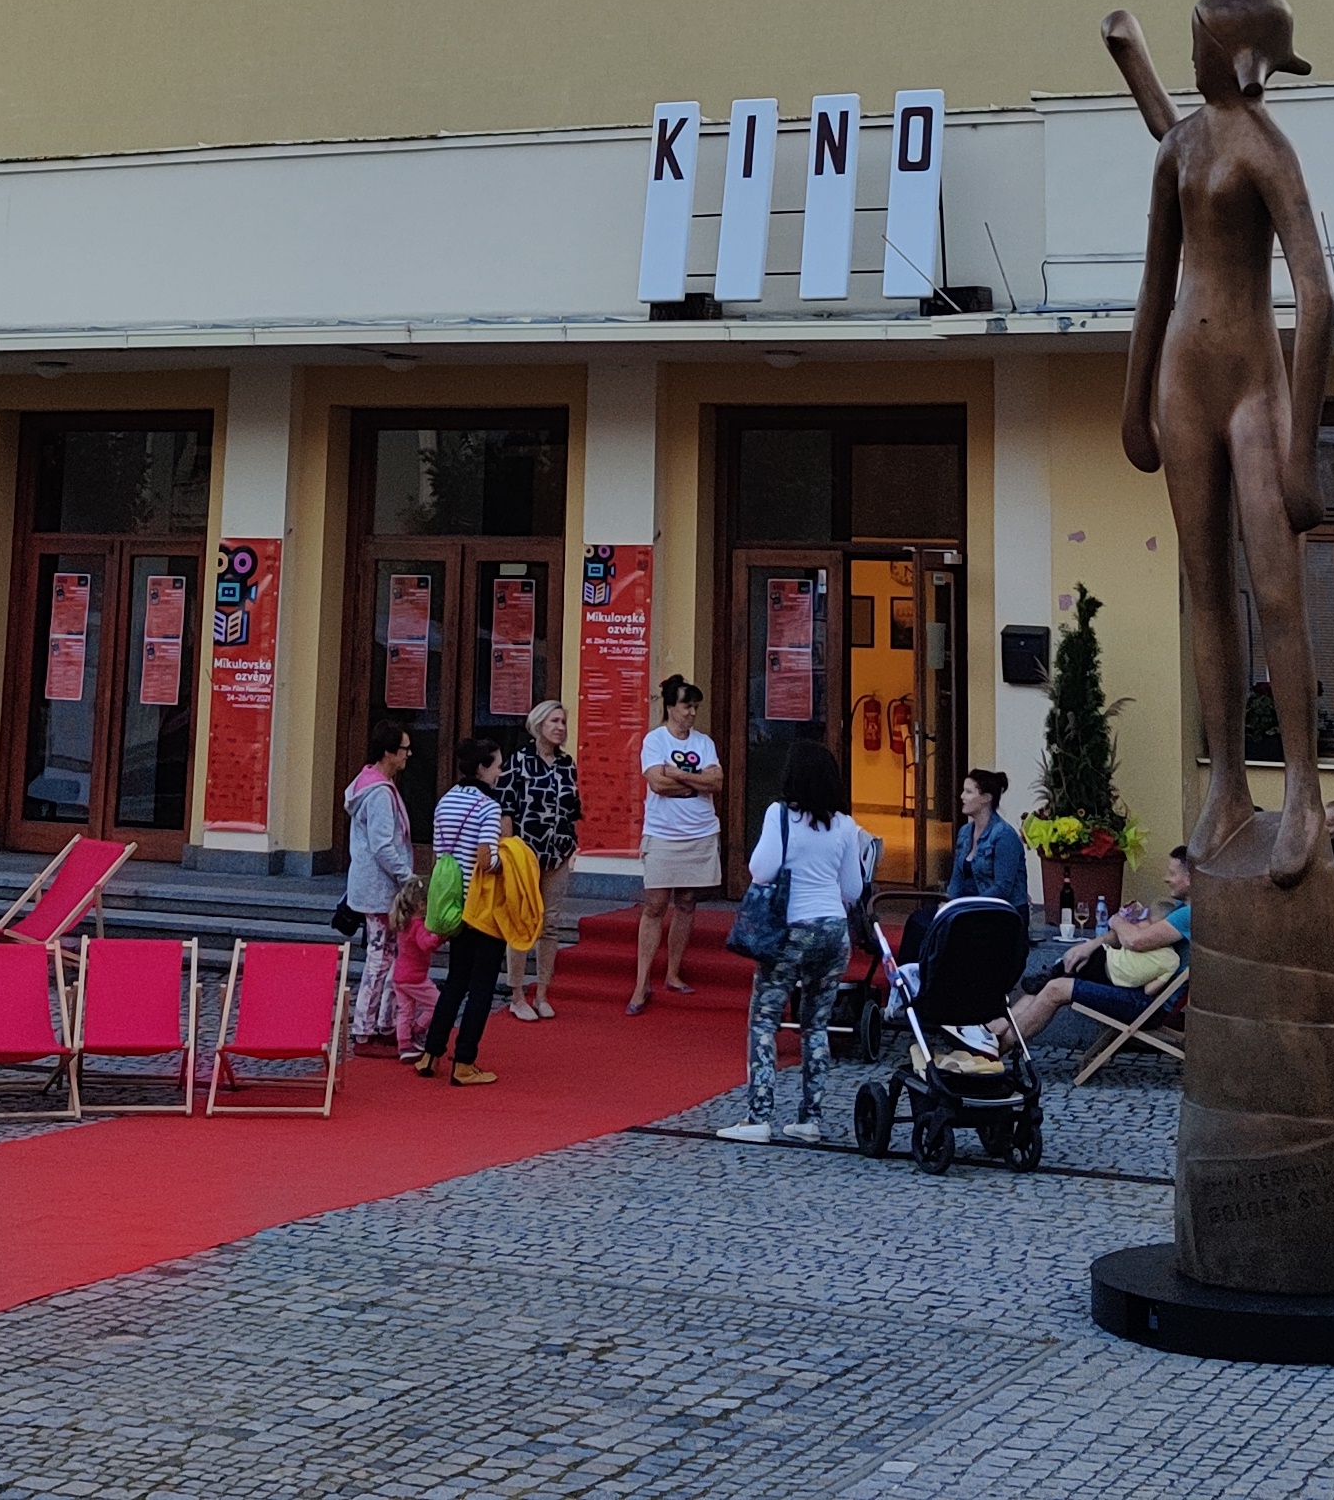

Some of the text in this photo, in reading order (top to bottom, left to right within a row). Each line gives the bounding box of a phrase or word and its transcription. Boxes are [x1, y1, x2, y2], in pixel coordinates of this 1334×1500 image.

[653, 105, 934, 181] KINO
[586, 612, 646, 624] Mikulovské
[607, 624, 646, 638] ozvěny
[214, 658, 272, 670] Mikulovské
[235, 671, 272, 684] ozvěny
